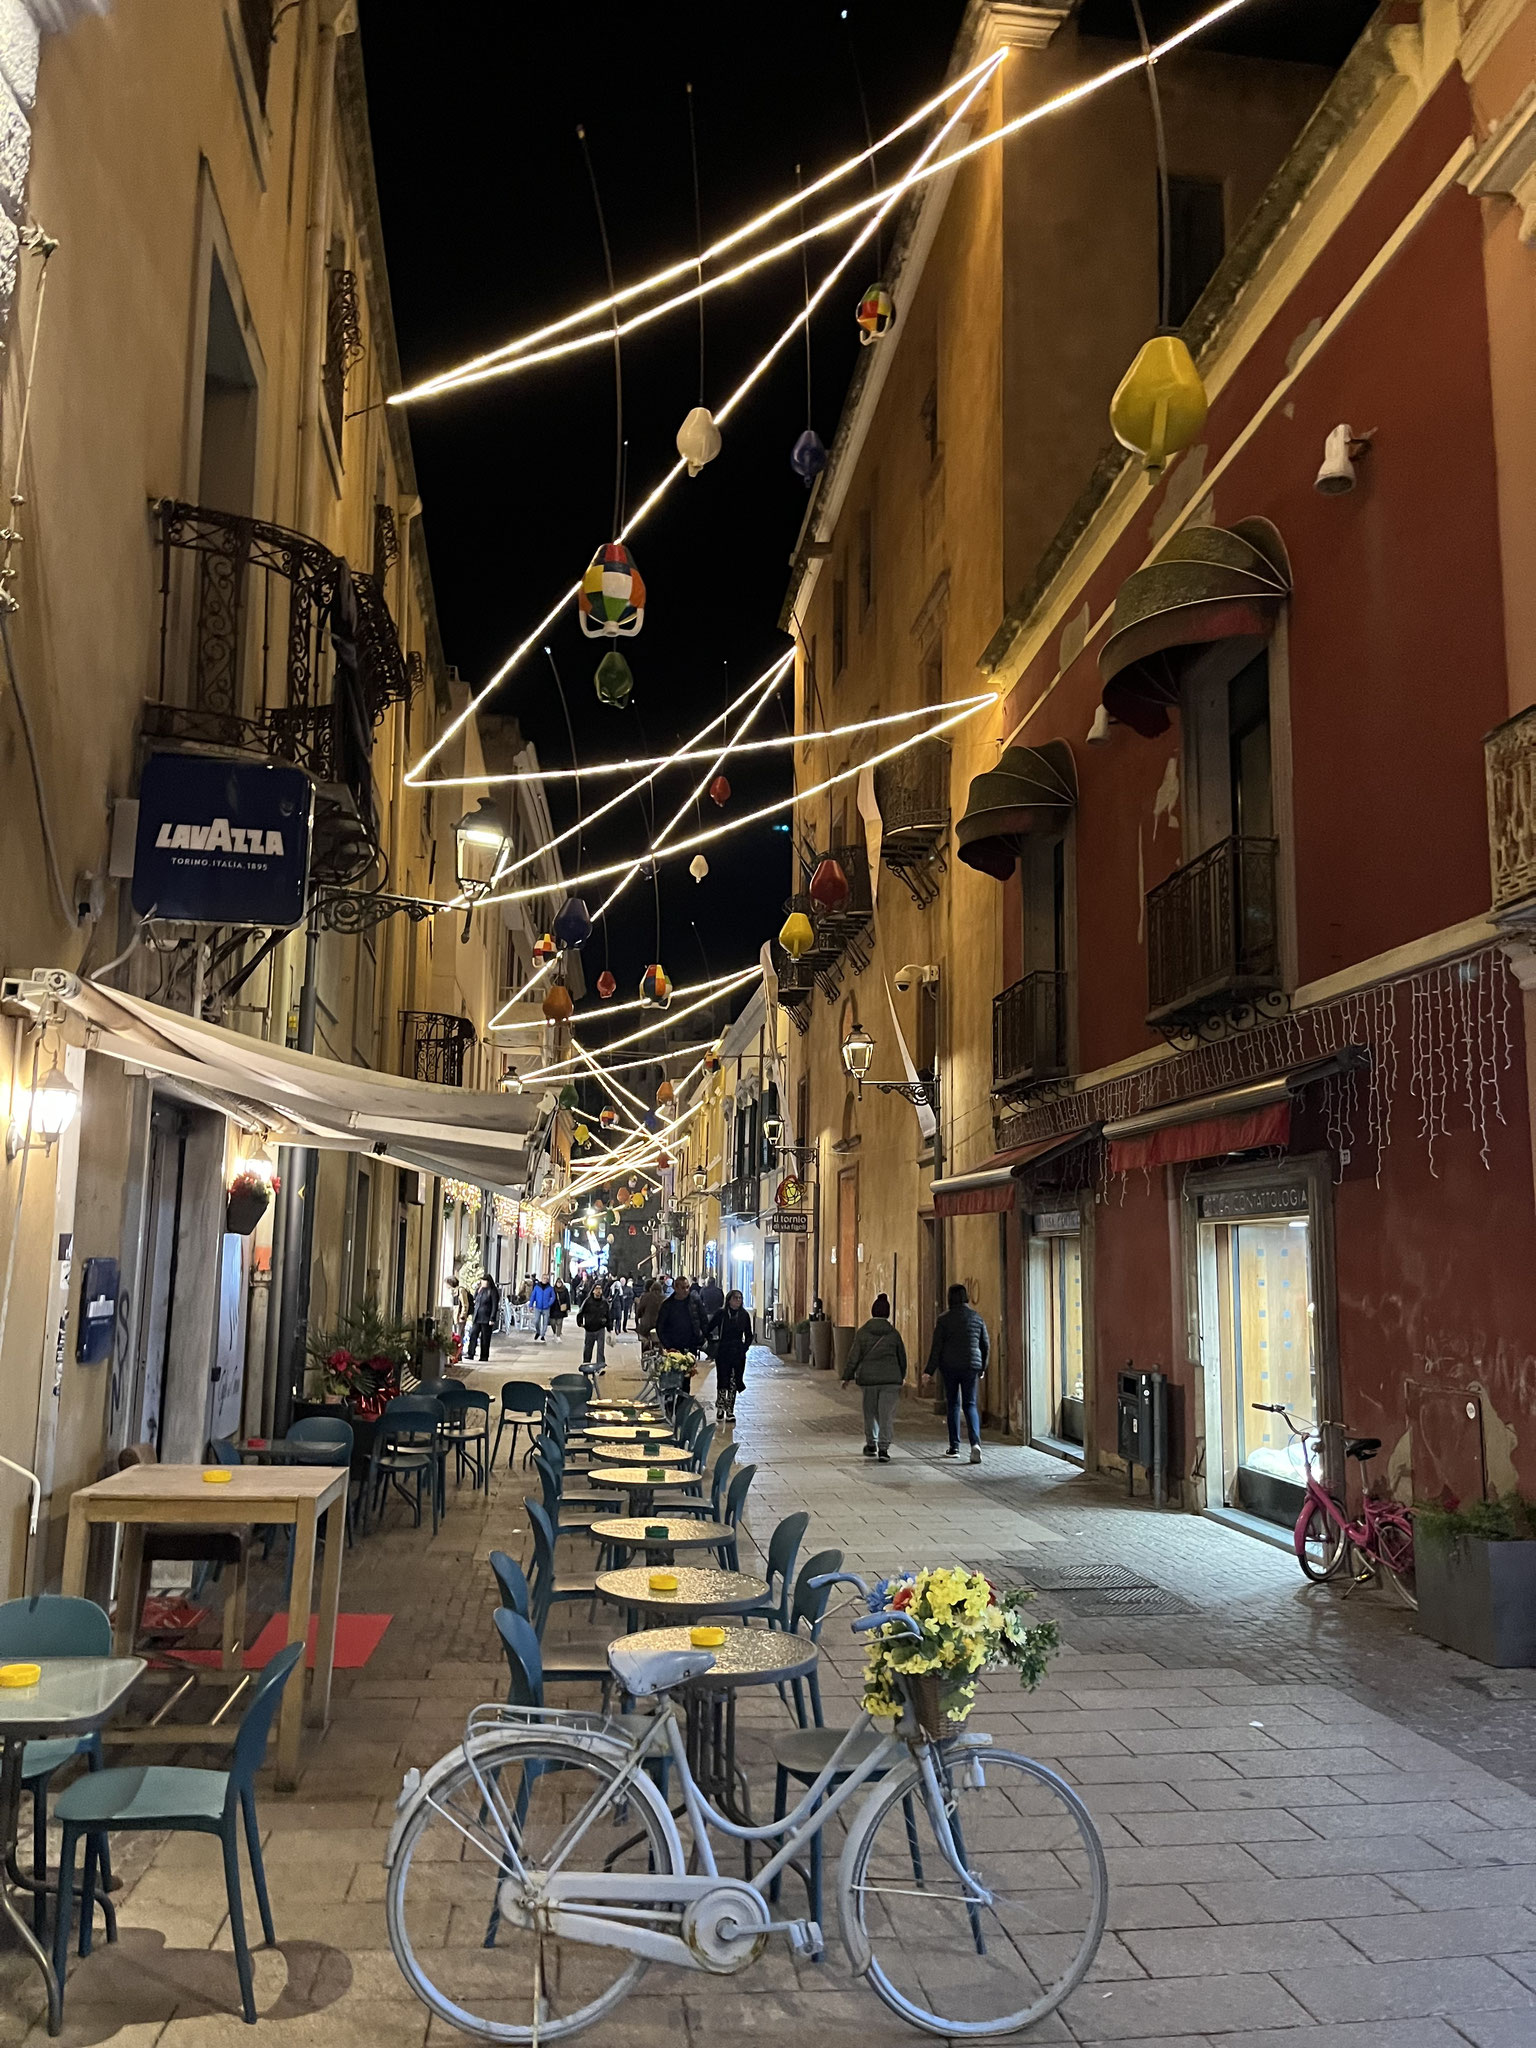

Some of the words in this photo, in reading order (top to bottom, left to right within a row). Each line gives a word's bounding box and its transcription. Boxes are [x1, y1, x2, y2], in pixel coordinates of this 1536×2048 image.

[155, 818, 284, 856] LAVAZZA
[247, 862, 268, 871] 1895
[780, 1215, 807, 1223] tornio
